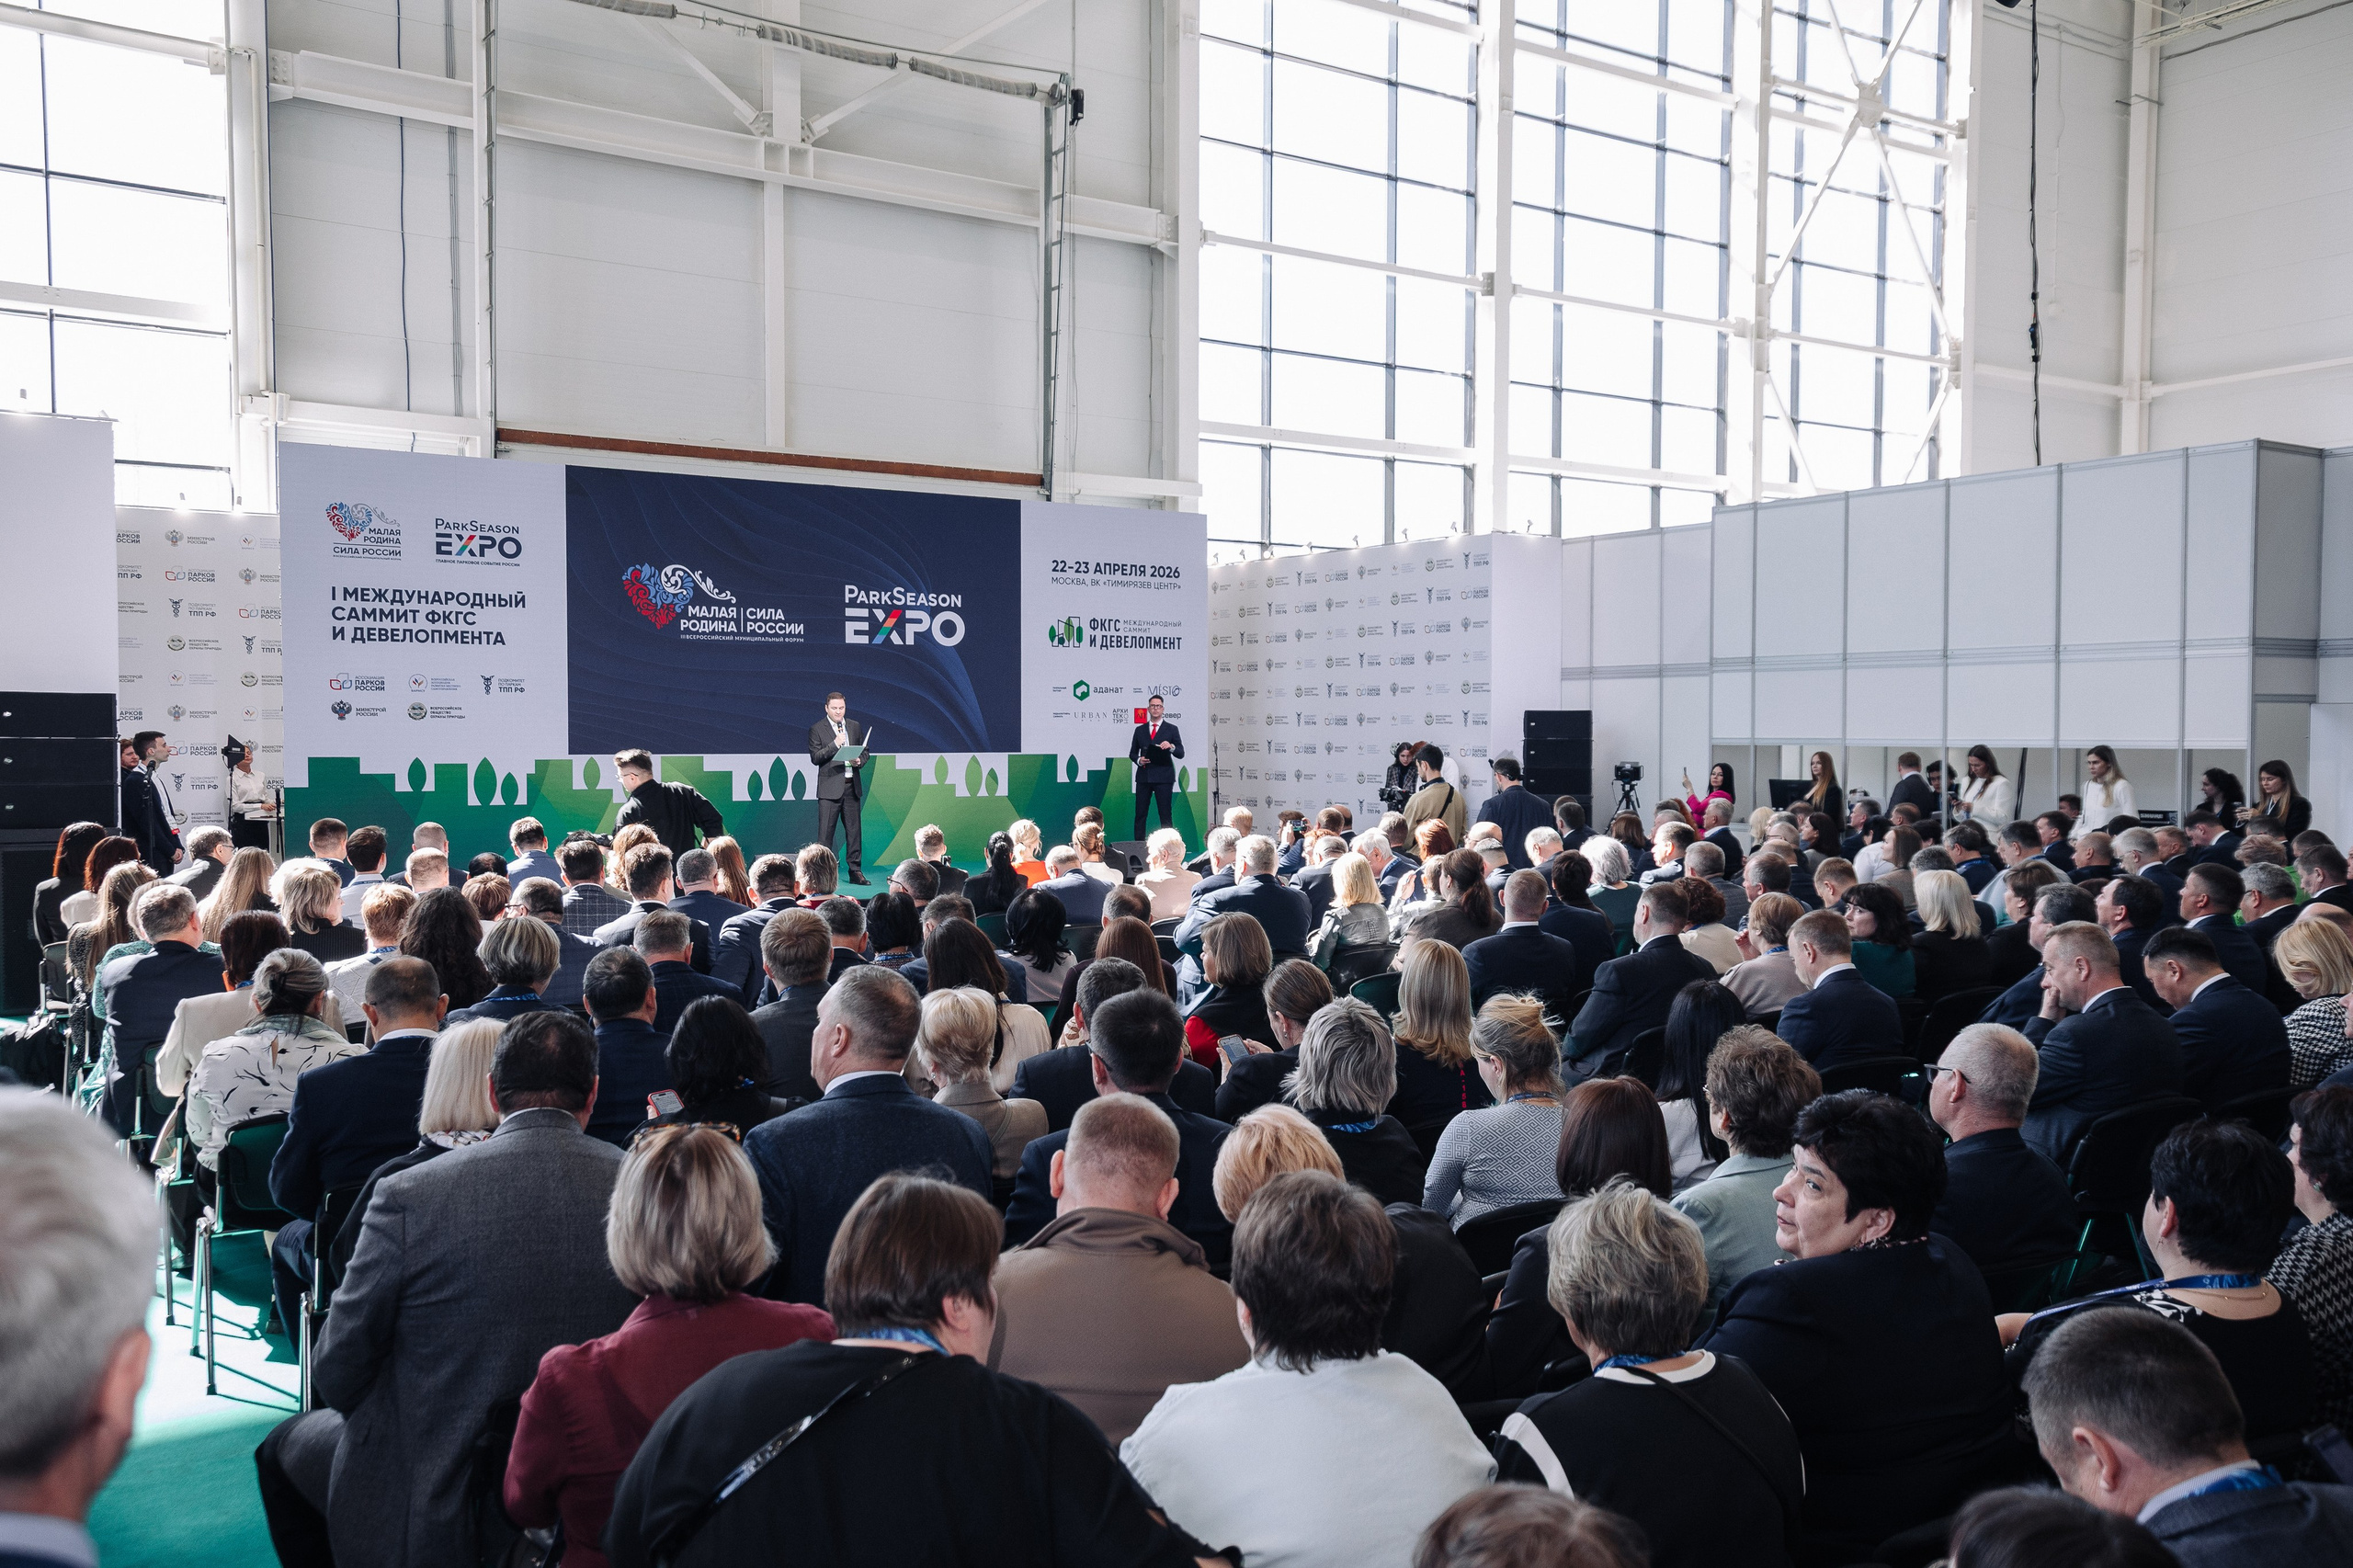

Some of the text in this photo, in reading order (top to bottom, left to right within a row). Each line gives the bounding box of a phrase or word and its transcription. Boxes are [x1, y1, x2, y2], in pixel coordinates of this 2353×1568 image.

[363, 536, 402, 545] РОДИНА
[369, 528, 401, 537] МАЛАЯ
[333, 546, 402, 557] СИЛА РОССИИ
[435, 532, 522, 560] EXPO
[1093, 562, 1146, 577] АПРЕЛЯ
[1150, 565, 1181, 578] 2026
[1051, 576, 1088, 586] МОСКВА,
[343, 586, 526, 609] МЕЖДУНАРОДНЫЙ
[331, 607, 477, 626] САММИТ ФКГС
[688, 606, 785, 620] МАЛАЯ СИЛА
[680, 619, 804, 635] РОДИНА РОССИИ
[845, 608, 966, 647] EXPO
[1089, 618, 1182, 632] ФКГС МЕЖДУНАРОДНЫЙ
[332, 626, 506, 646] И ДЕВЕЛОПМЕНТА
[1089, 634, 1182, 650] И ДЕВЕЛОПМЕНТ
